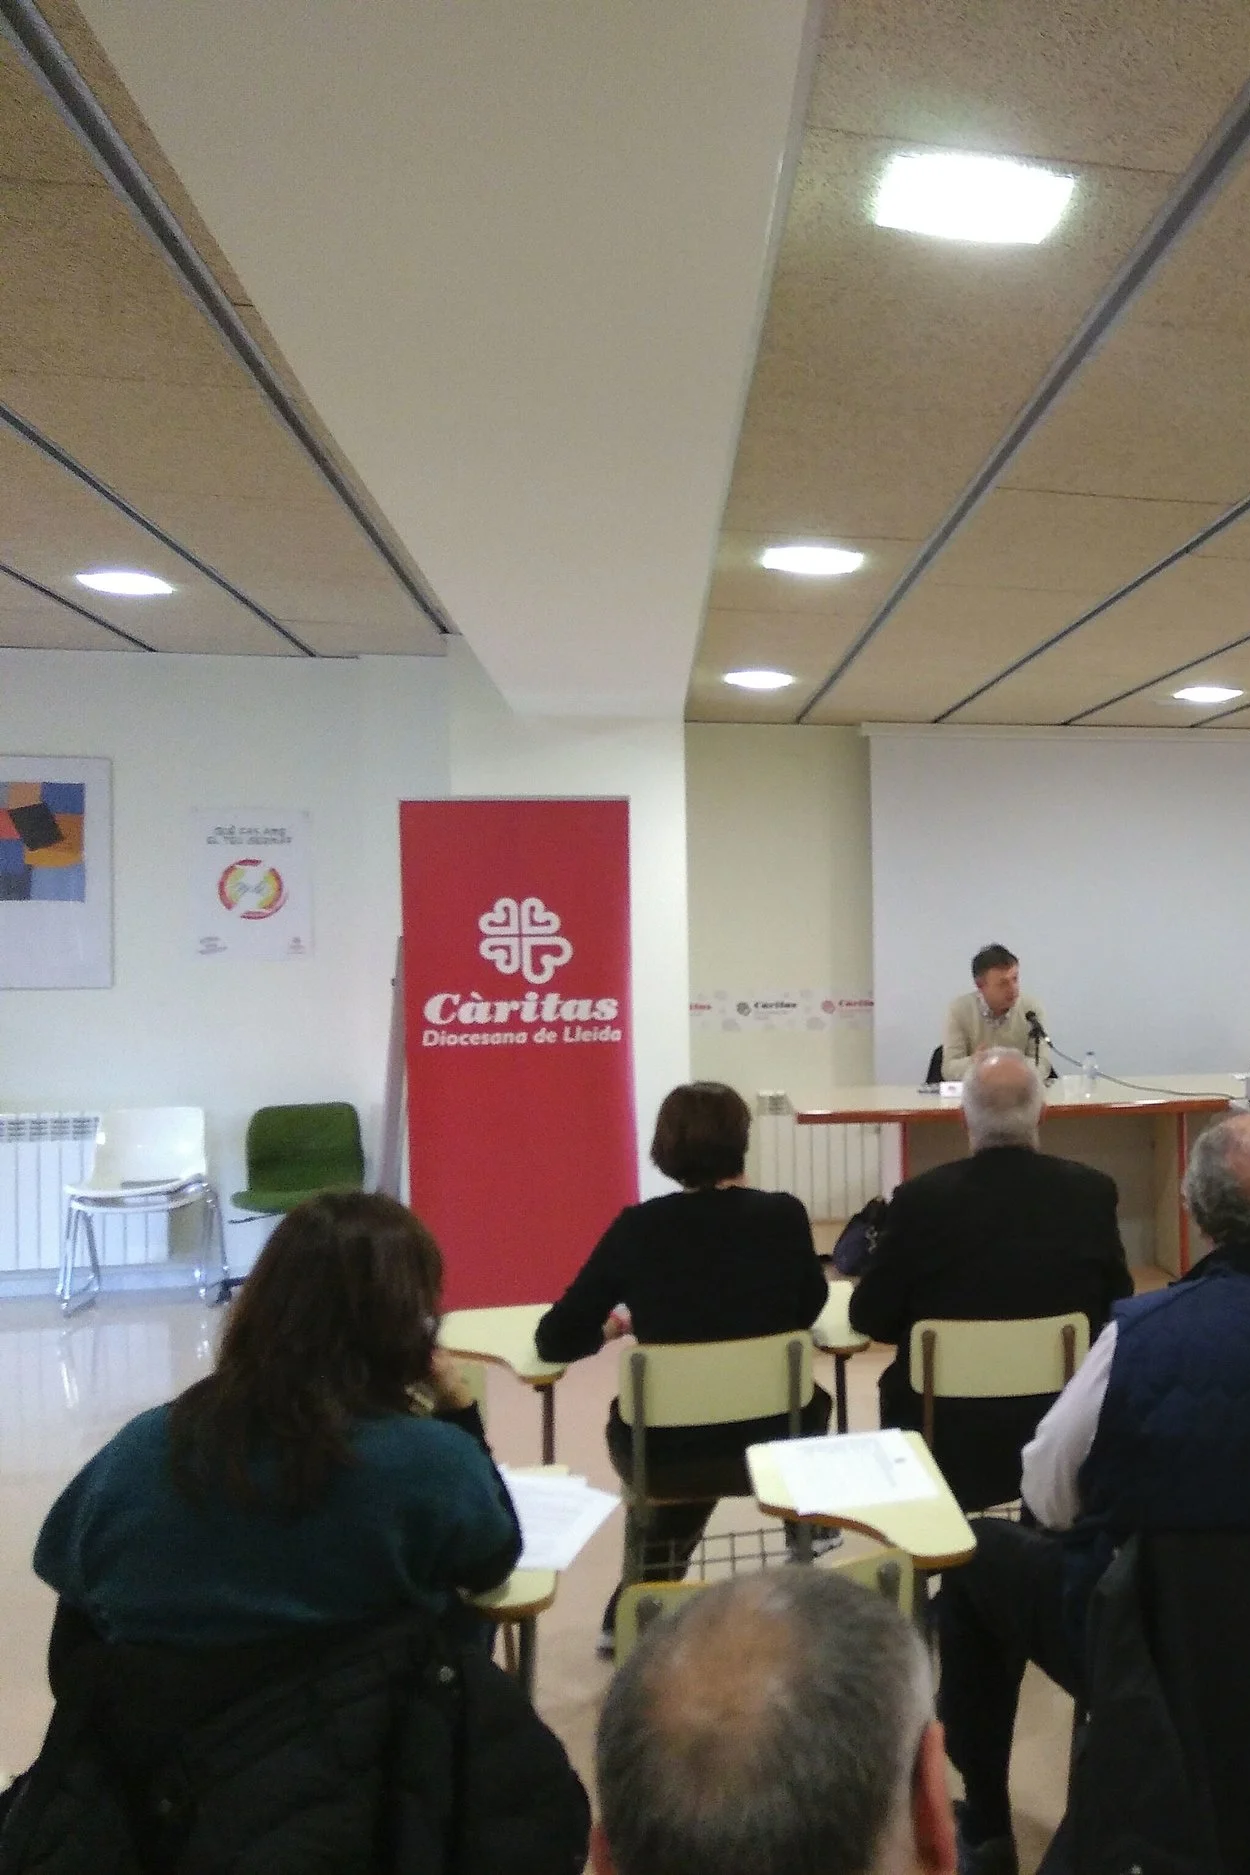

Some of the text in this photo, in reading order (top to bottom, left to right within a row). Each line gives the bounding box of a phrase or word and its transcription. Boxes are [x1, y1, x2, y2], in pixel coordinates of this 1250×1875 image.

[423, 991, 620, 1025] Càritas
[422, 1025, 622, 1046] Diocesana de Lleida
